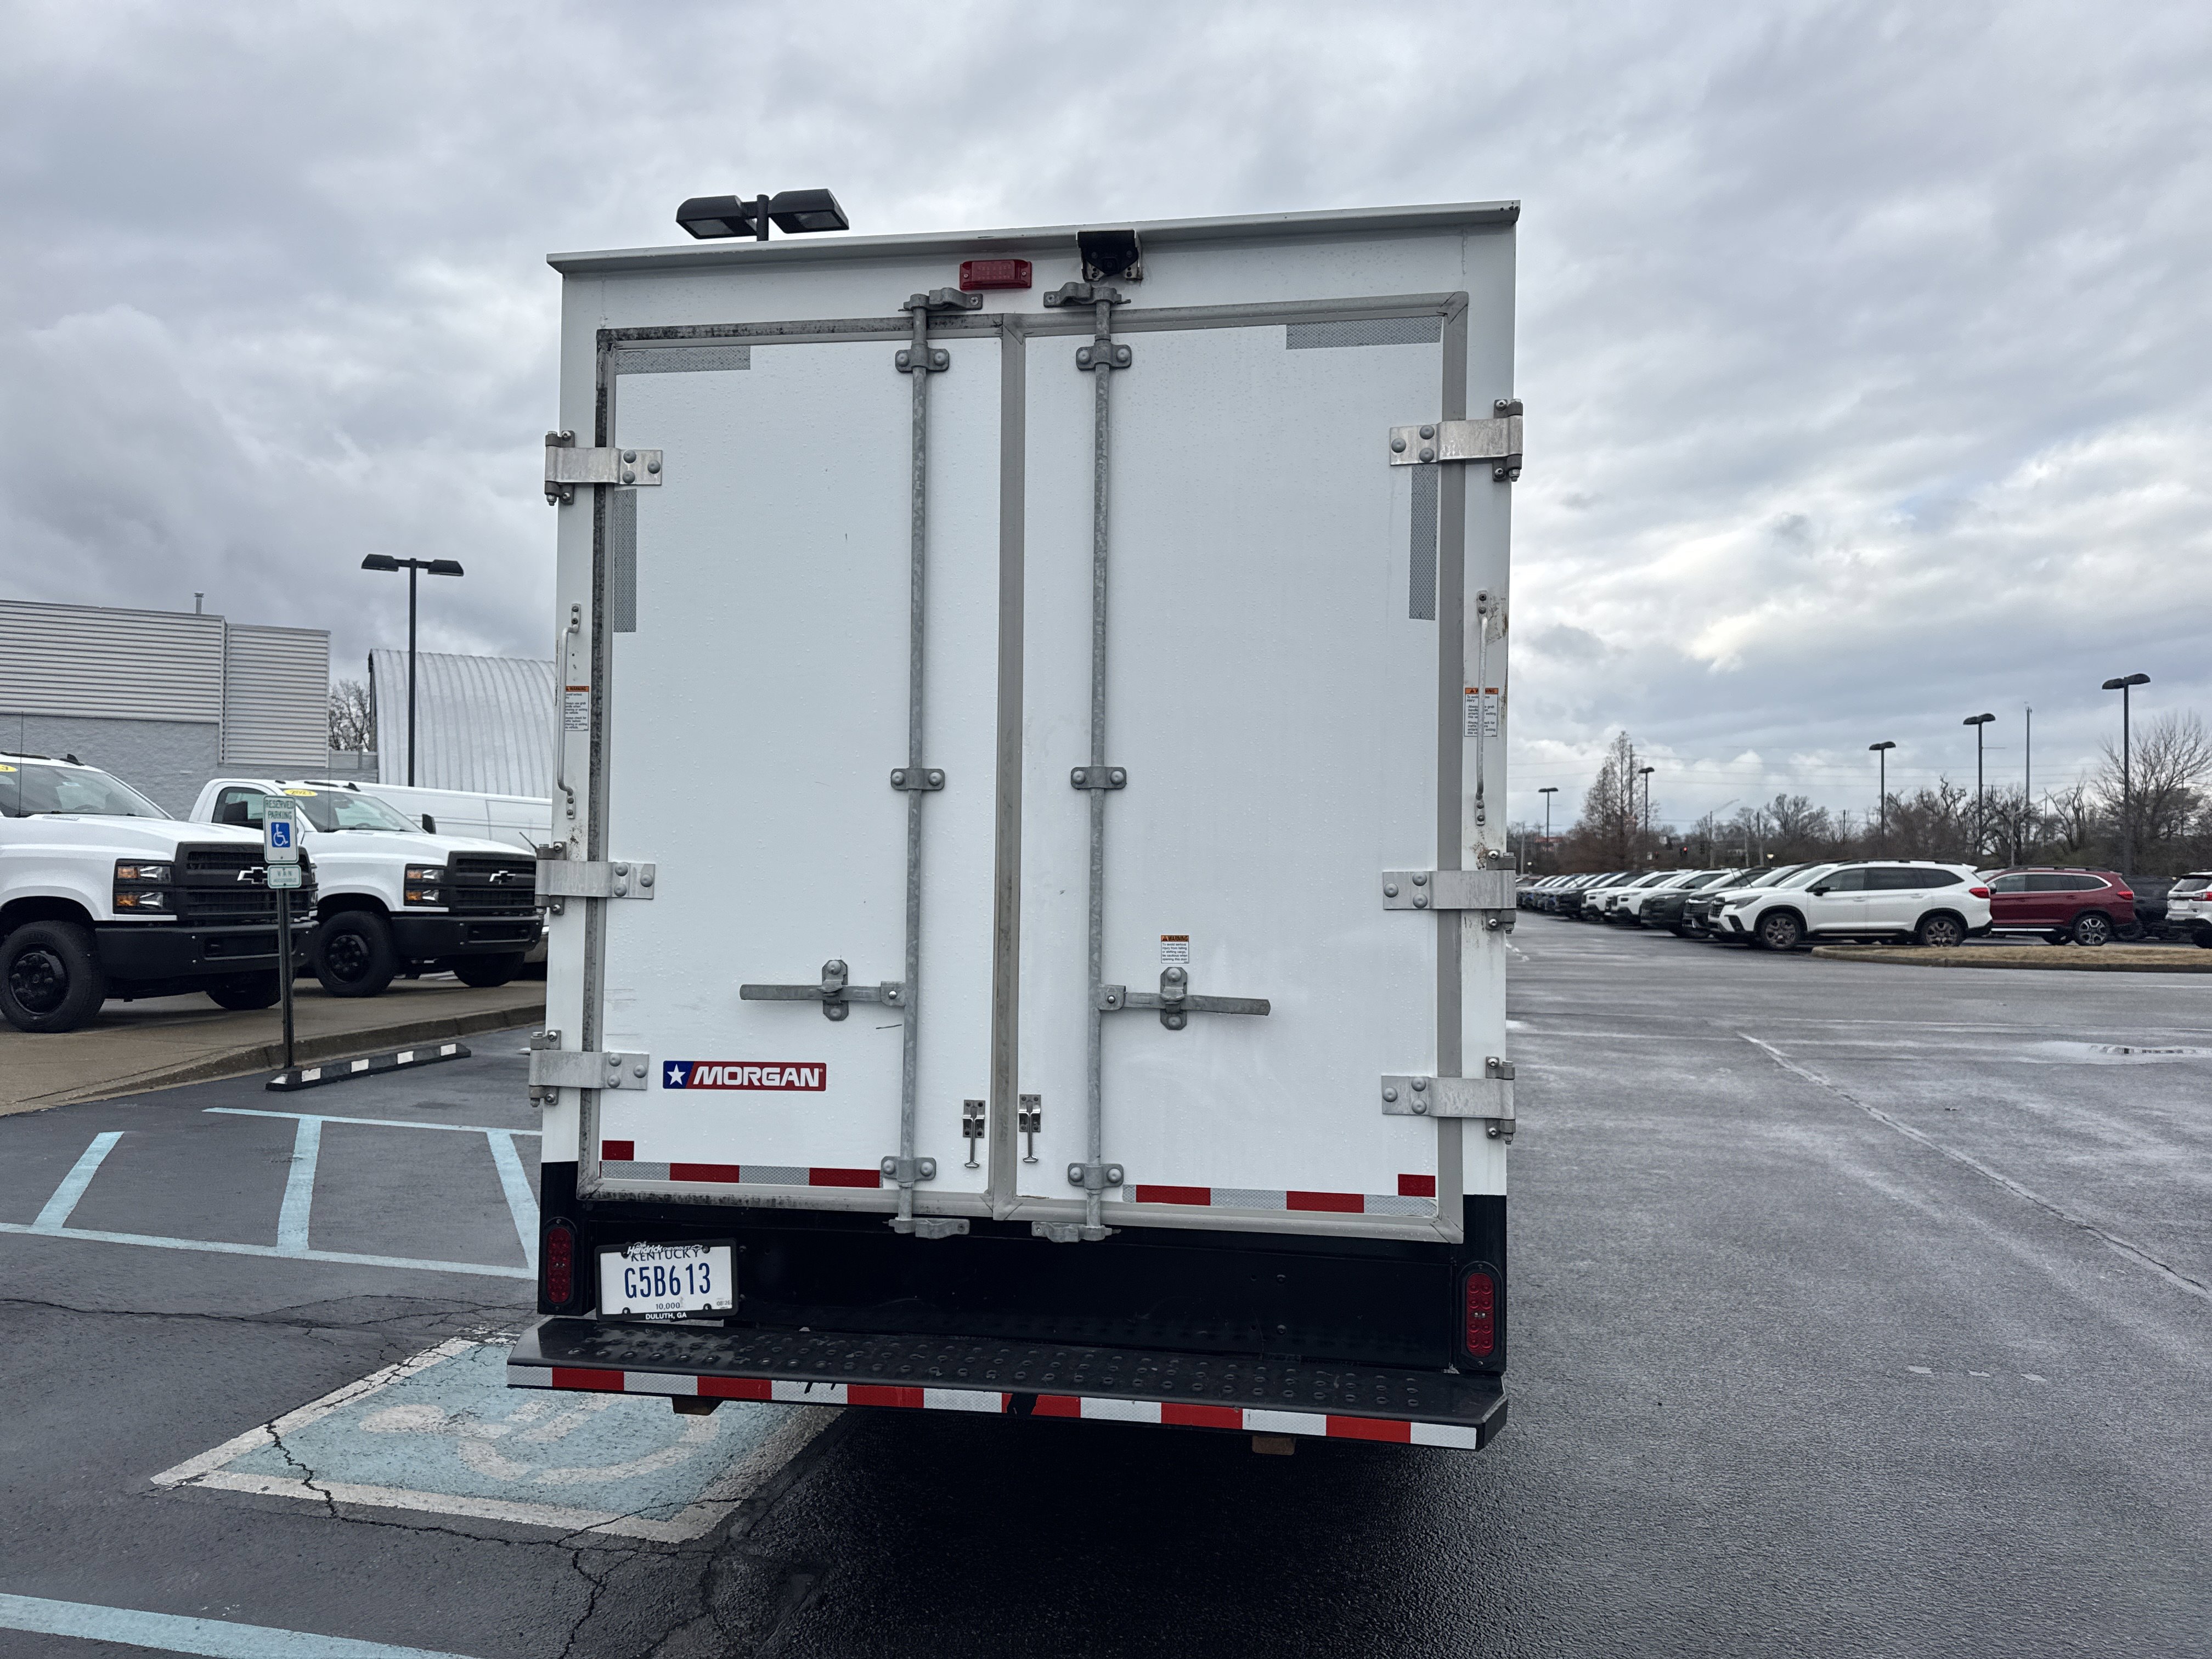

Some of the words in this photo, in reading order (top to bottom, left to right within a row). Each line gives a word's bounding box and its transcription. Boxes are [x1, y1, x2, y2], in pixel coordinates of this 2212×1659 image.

[265, 799, 295, 809] RESERVED
[268, 811, 292, 820] PARKING
[692, 1066, 819, 1087] MORGAN
[627, 1244, 663, 1255] Hendrick
[631, 1249, 699, 1262] KENTUCKY
[624, 1262, 711, 1299] G5B613
[655, 1302, 680, 1310] 10,000
